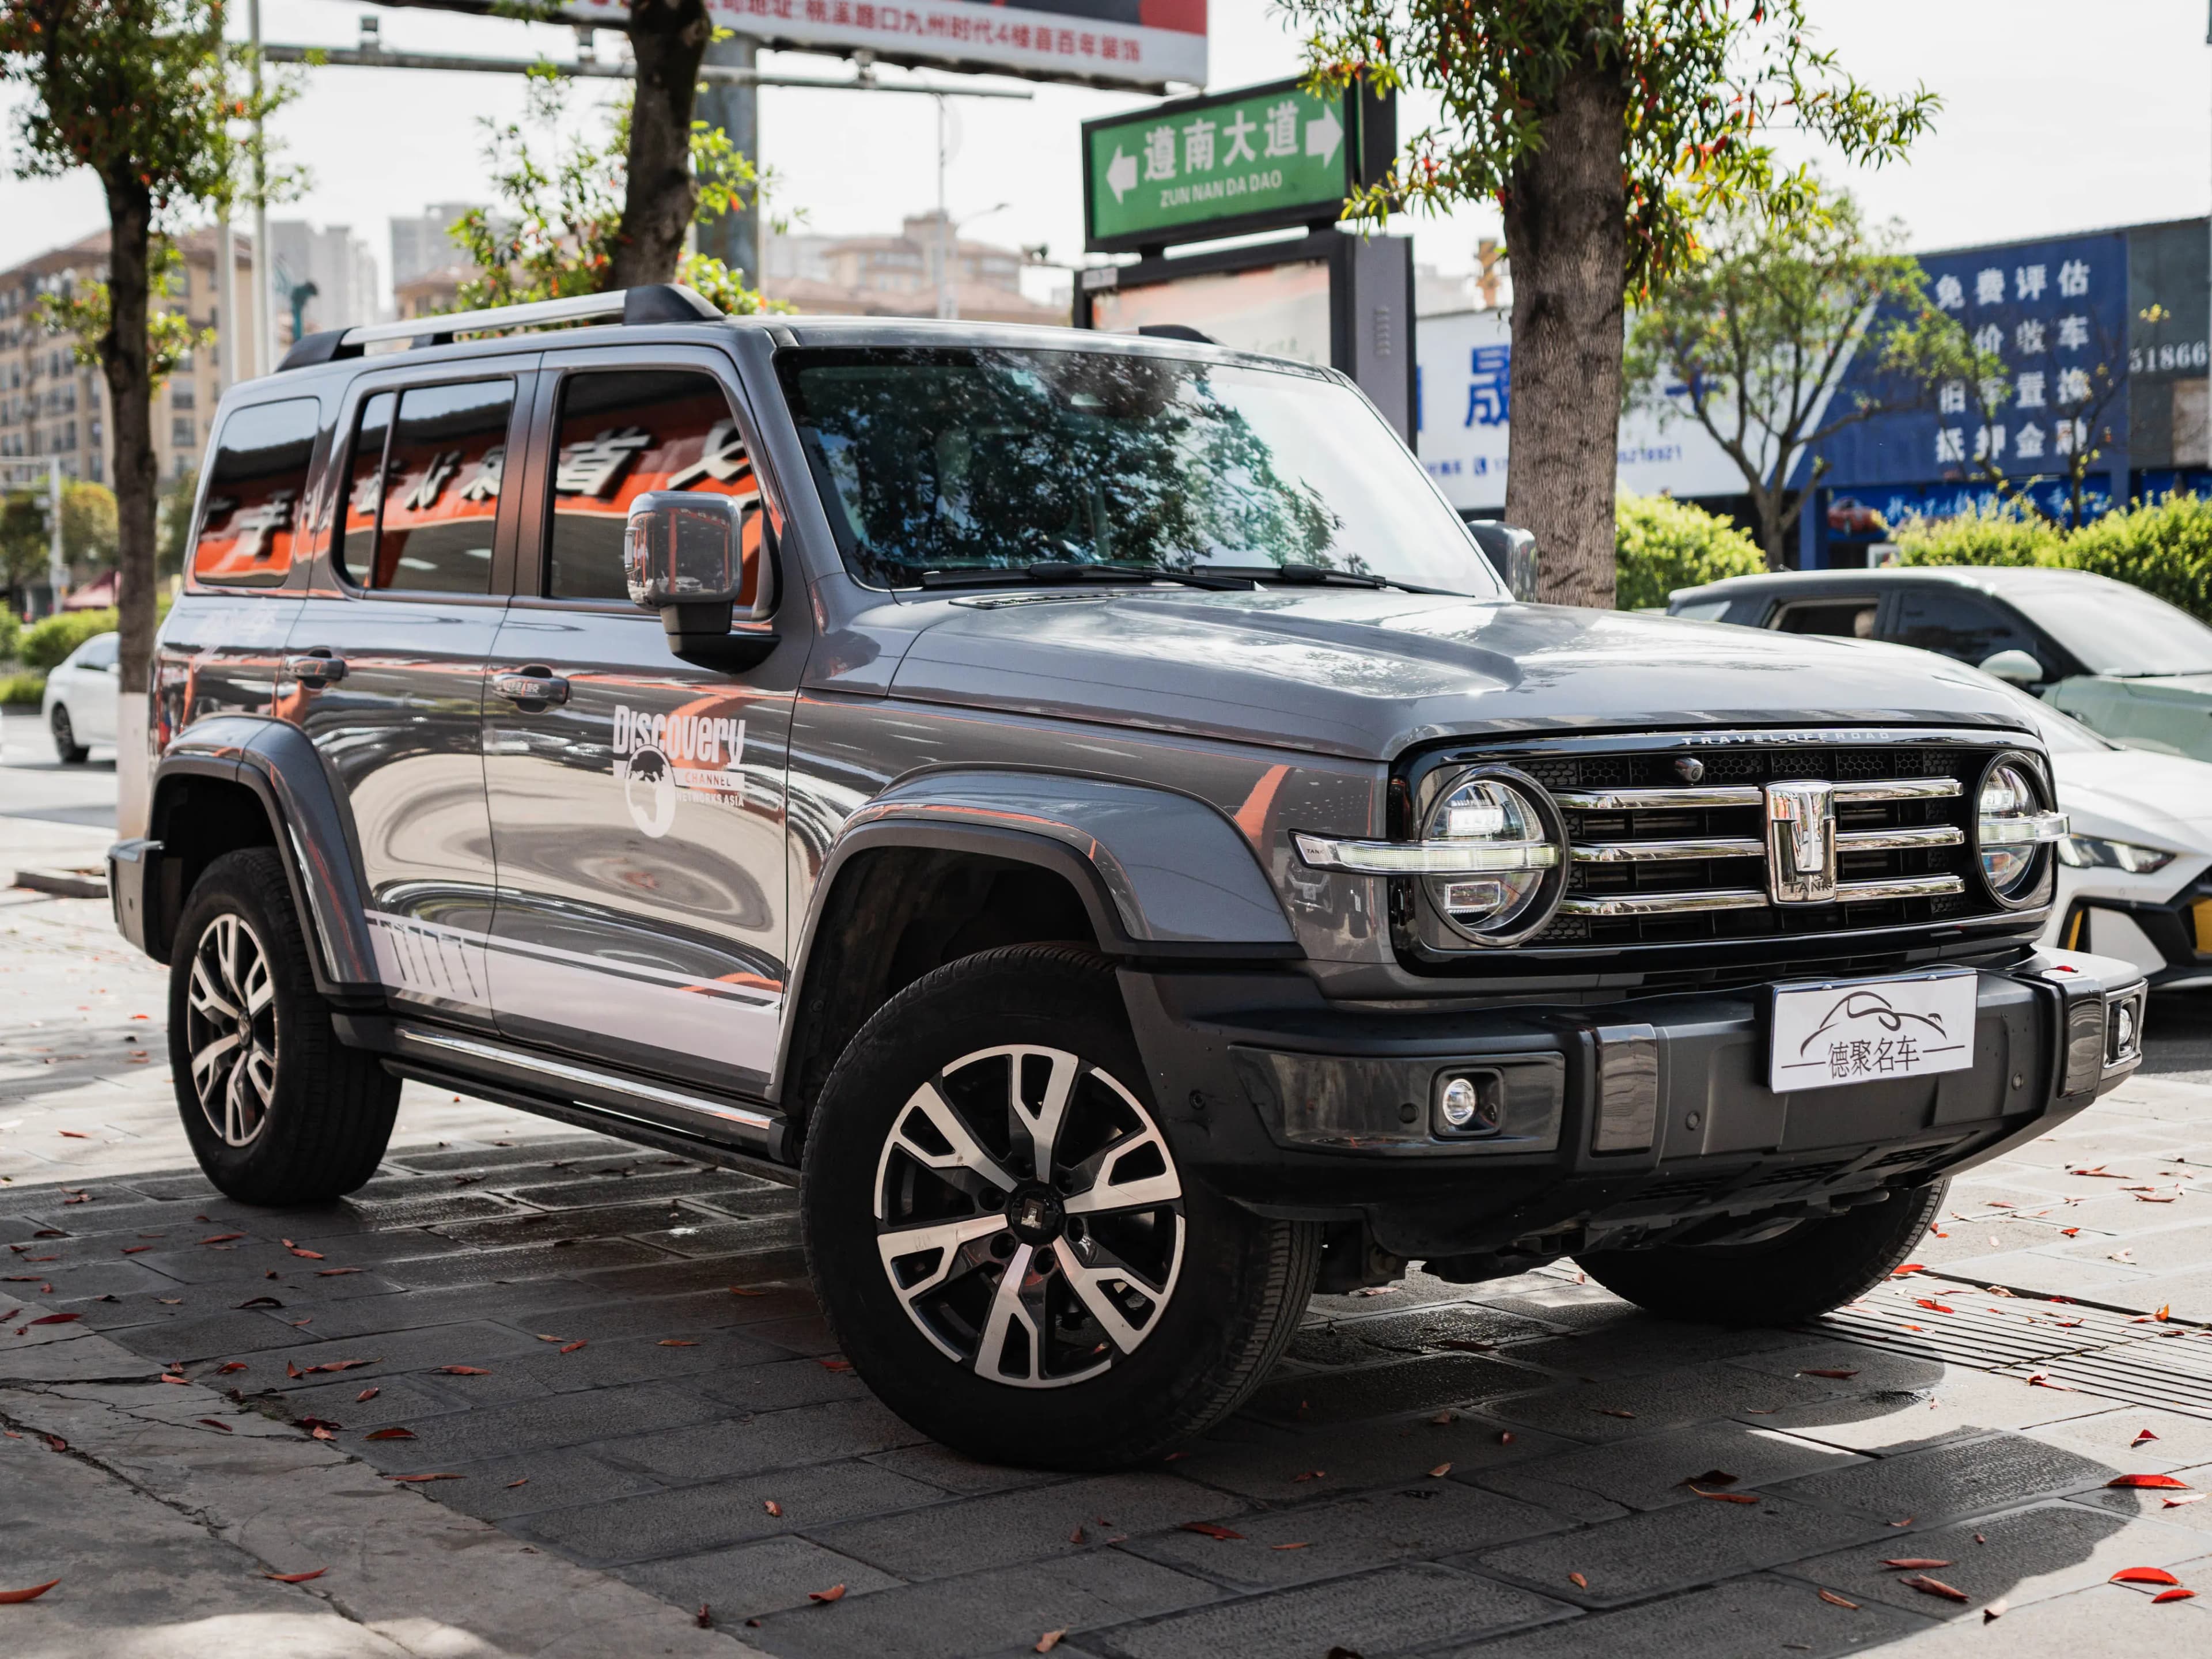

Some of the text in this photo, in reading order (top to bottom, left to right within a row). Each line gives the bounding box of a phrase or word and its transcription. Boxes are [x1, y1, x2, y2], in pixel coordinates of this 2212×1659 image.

[1143, 100, 1300, 181] 遵南大道
[1160, 170, 1283, 208] ZUN NAN DA DAO
[1935, 259, 2090, 310] 免费评估
[1939, 314, 2089, 365] 价收车
[675, 790, 744, 807] NETWORKS ASIA
[685, 771, 731, 787] CHANNEL
[1785, 880, 1833, 893] TANK
[1828, 1035, 1920, 1079] 德聚名车
